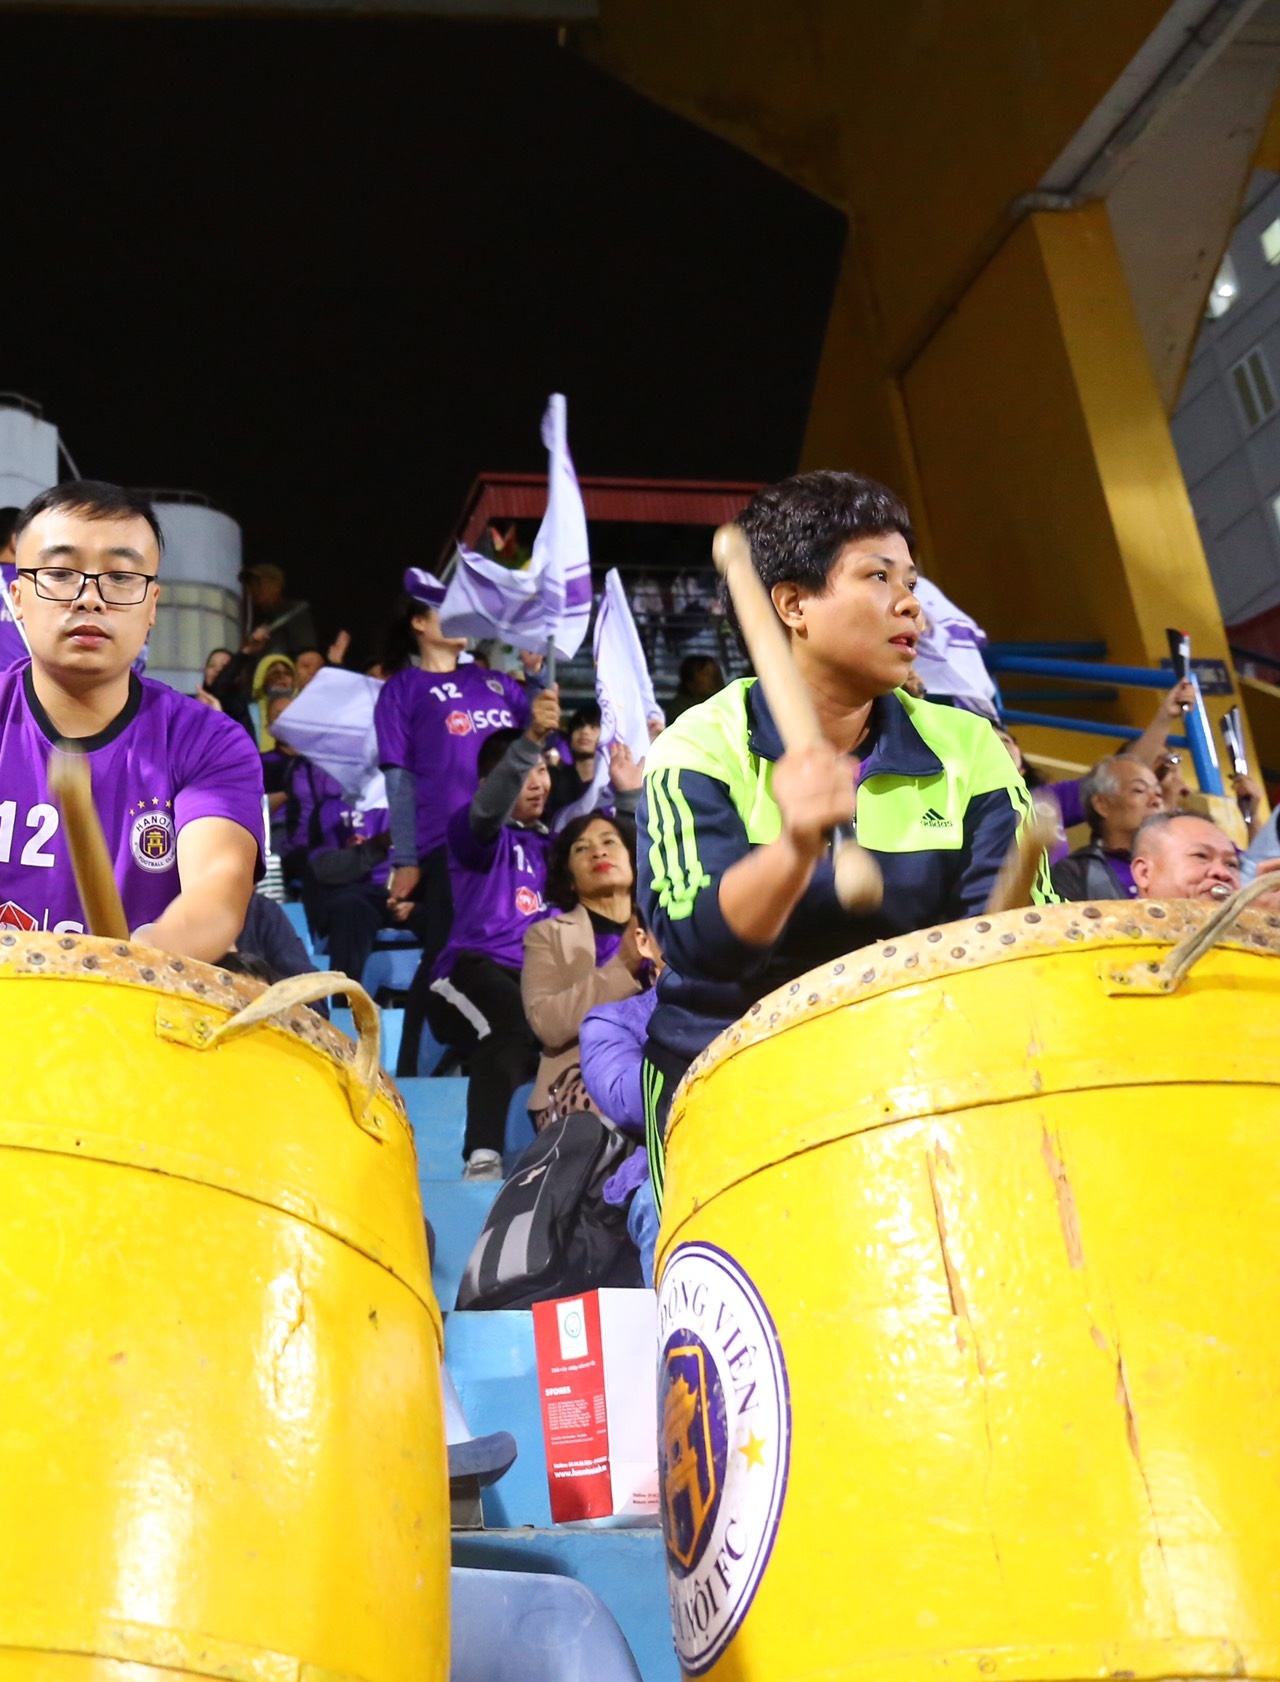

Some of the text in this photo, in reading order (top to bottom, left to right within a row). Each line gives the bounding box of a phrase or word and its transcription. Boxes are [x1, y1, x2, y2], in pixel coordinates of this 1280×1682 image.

[429, 682, 463, 702] 12
[135, 815, 171, 832] HANOI
[340, 811, 365, 828] 12
[920, 820, 953, 828] adidas
[138, 856, 164, 867] FOOTBALL
[714, 1302, 759, 1416] VIÊN
[544, 1386, 572, 1397] STORES
[713, 1517, 748, 1597] FC
